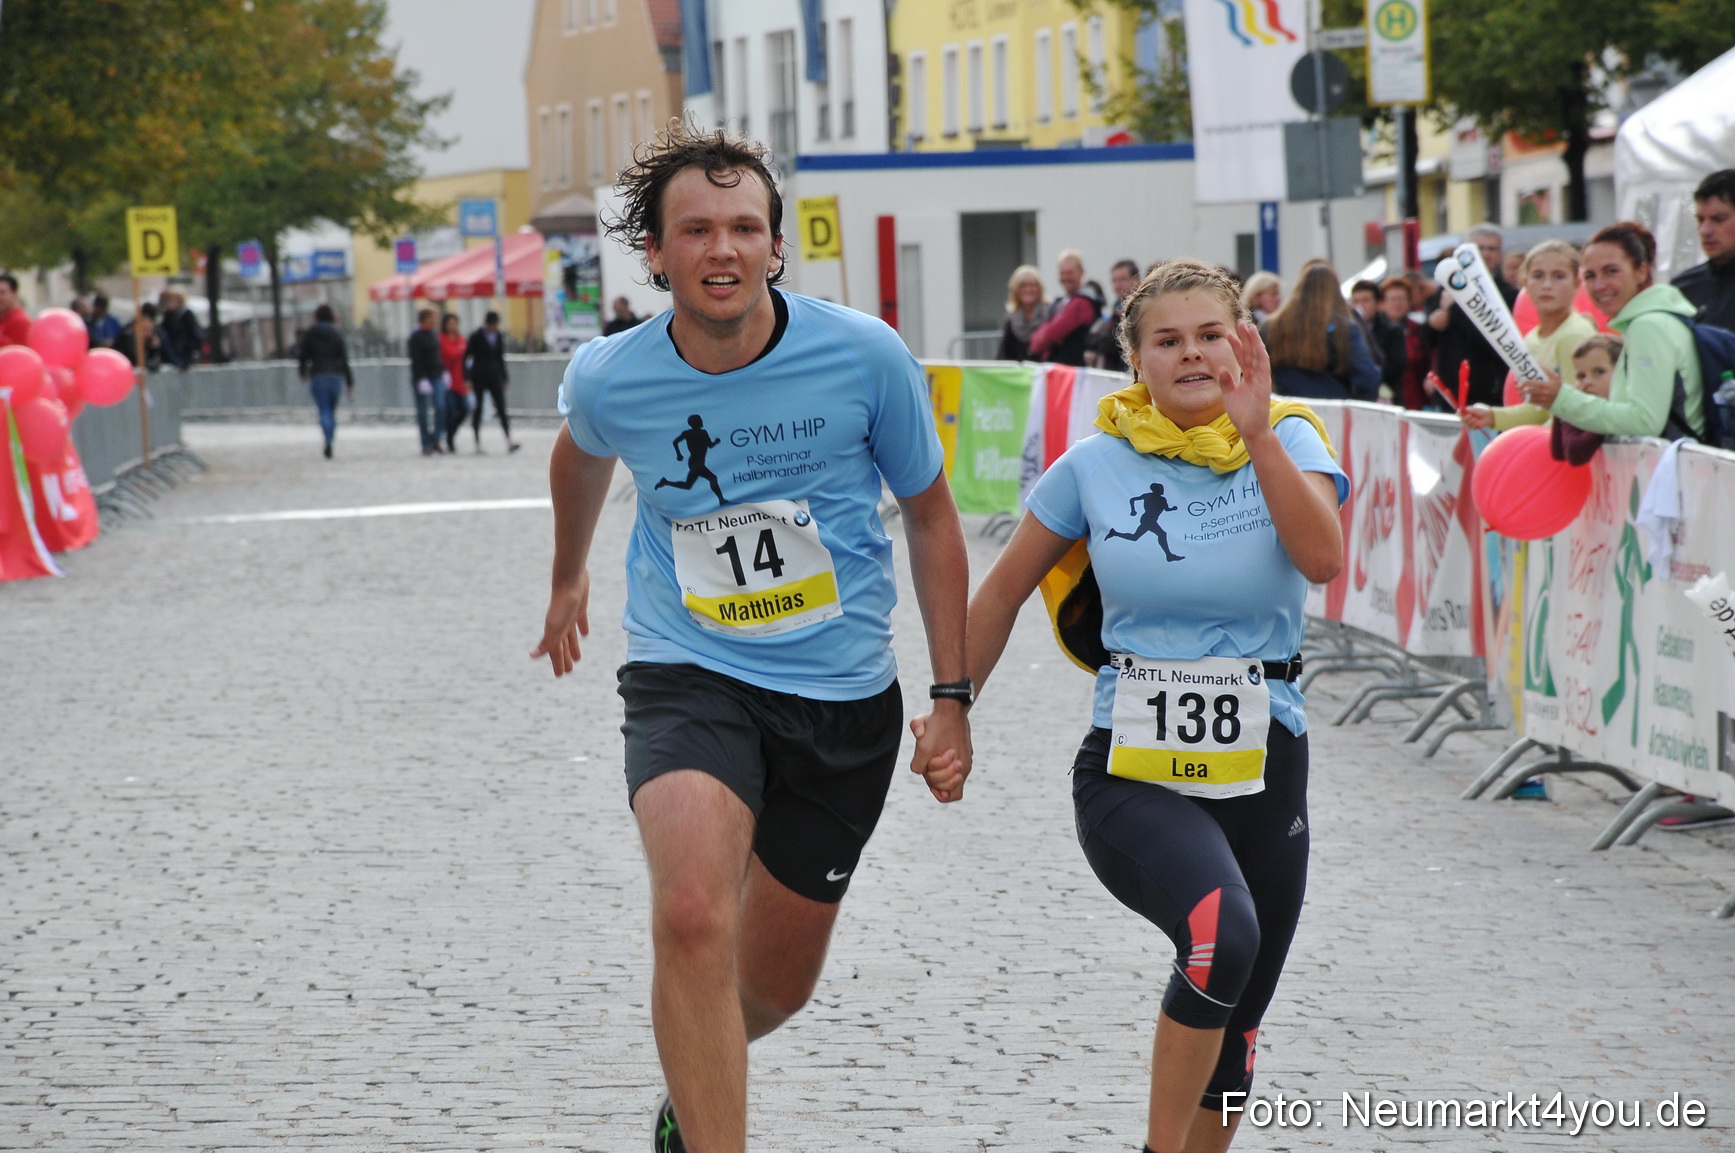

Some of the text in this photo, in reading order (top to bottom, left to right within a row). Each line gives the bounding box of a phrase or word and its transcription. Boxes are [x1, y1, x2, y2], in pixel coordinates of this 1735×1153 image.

[142, 229, 165, 260] D
[810, 216, 831, 247] D
[1467, 293, 1502, 334] BMW
[730, 417, 826, 448] GYM HIP
[732, 460, 827, 484] Halbmarathon
[746, 449, 812, 467] P-Seminar
[1187, 488, 1236, 517] GYM
[1200, 506, 1261, 531] P-Seminar
[715, 528, 785, 587] 14
[718, 592, 804, 621] Matthias
[1121, 667, 1244, 686] PARTL Neumarkt
[1147, 691, 1241, 744] 138
[1172, 758, 1208, 778] Lea
